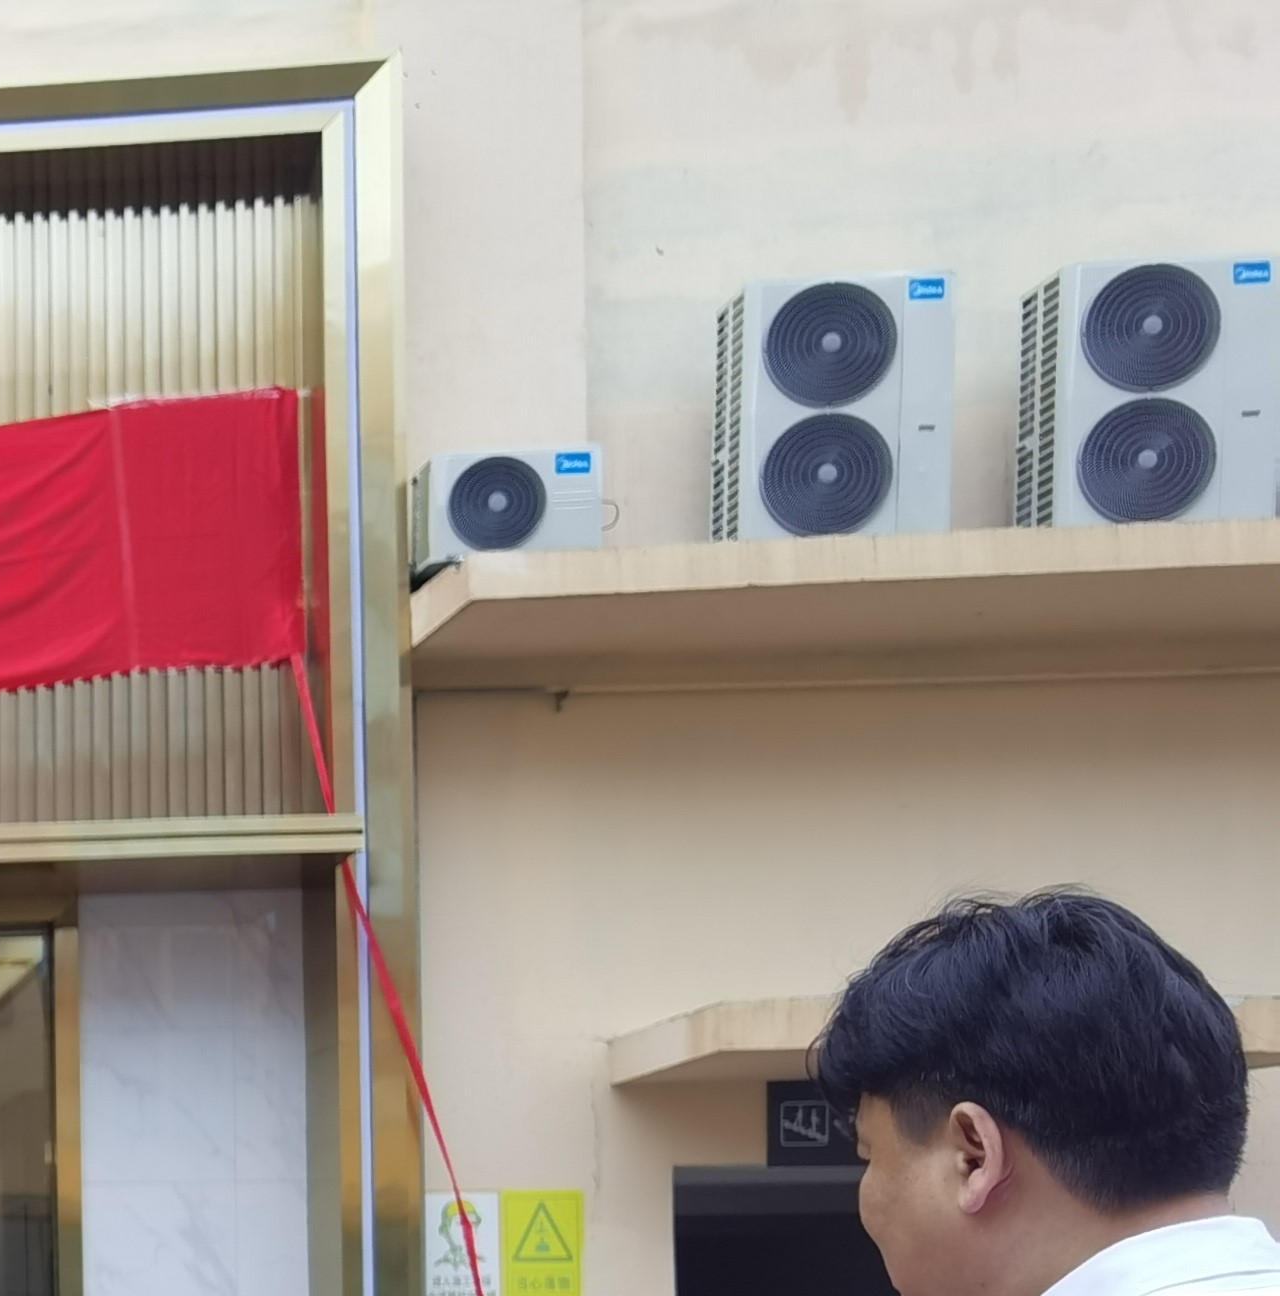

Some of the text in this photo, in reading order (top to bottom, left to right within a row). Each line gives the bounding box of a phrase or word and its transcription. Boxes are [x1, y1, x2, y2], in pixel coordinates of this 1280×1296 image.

[557, 456, 589, 470] Midea
[432, 1275, 492, 1287] 进入施工场
